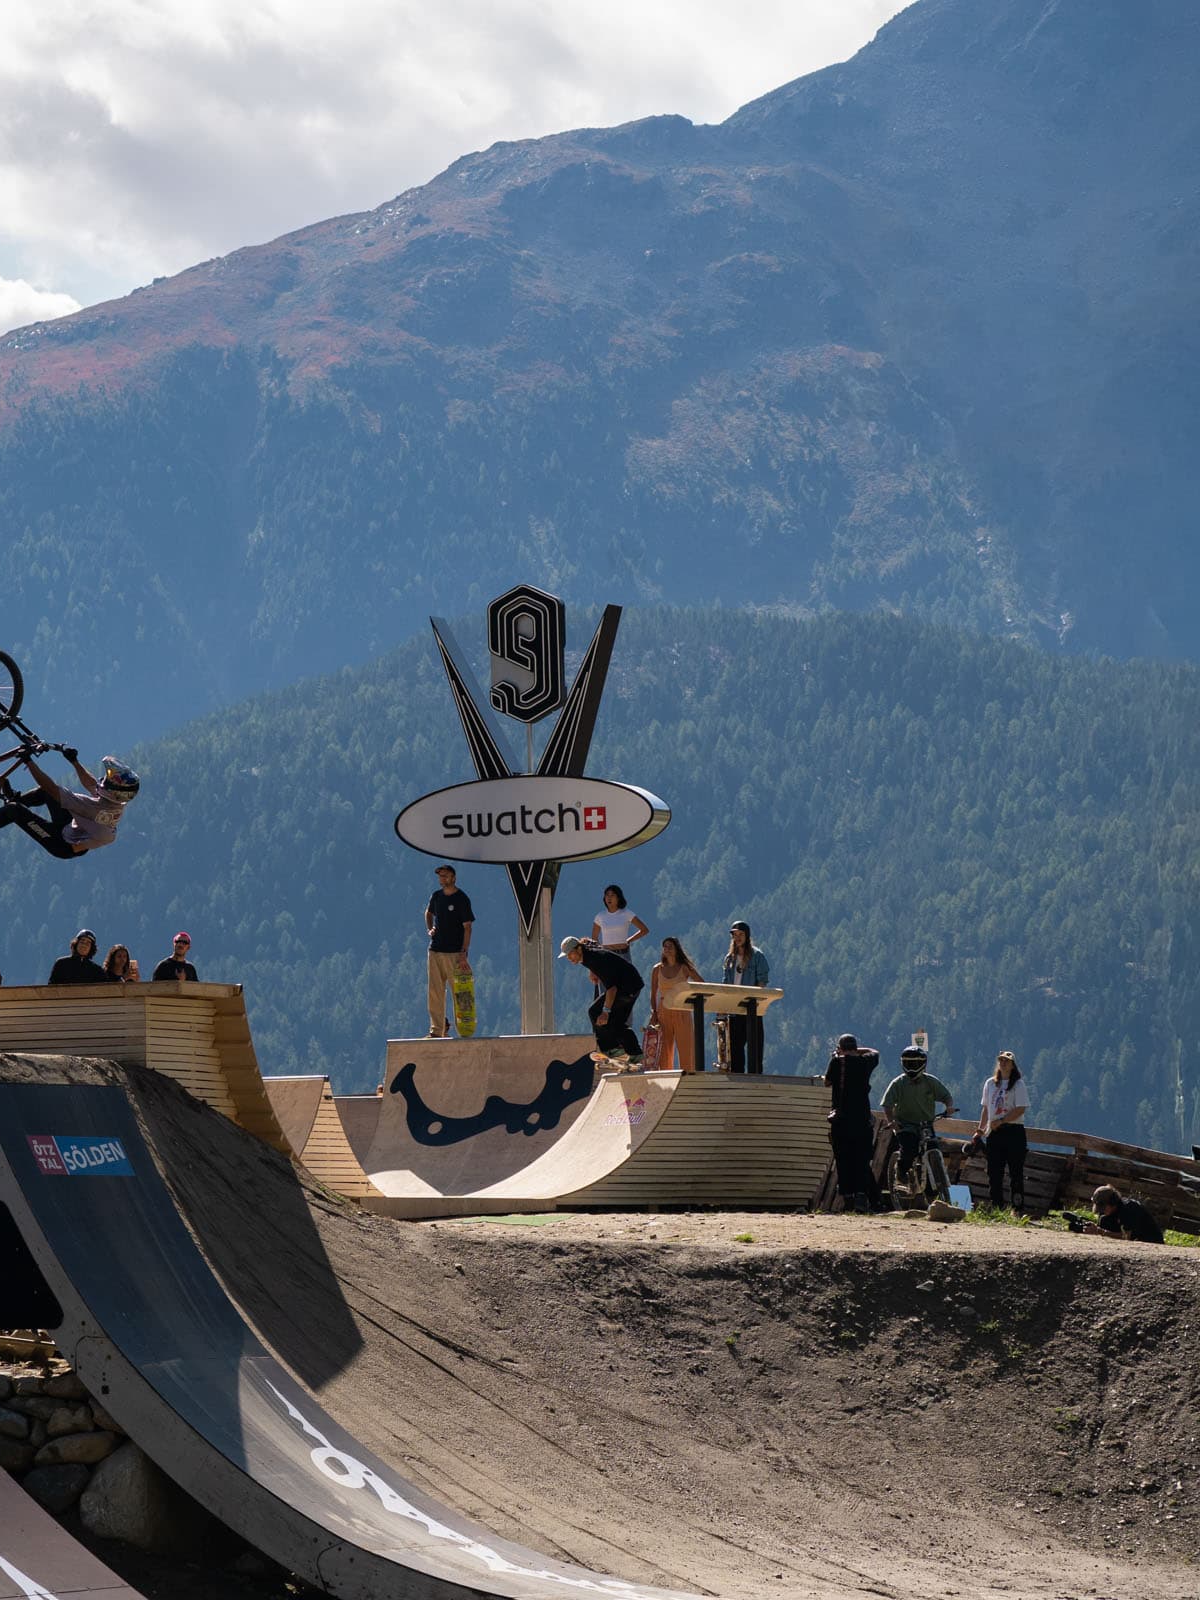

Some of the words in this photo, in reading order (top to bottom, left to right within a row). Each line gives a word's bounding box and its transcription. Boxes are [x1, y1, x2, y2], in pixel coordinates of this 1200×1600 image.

[441, 802, 580, 839] swatch
[32, 1139, 54, 1156] ÖTZ
[63, 1141, 126, 1171] SÖLDEN
[38, 1157, 62, 1170] TAL
